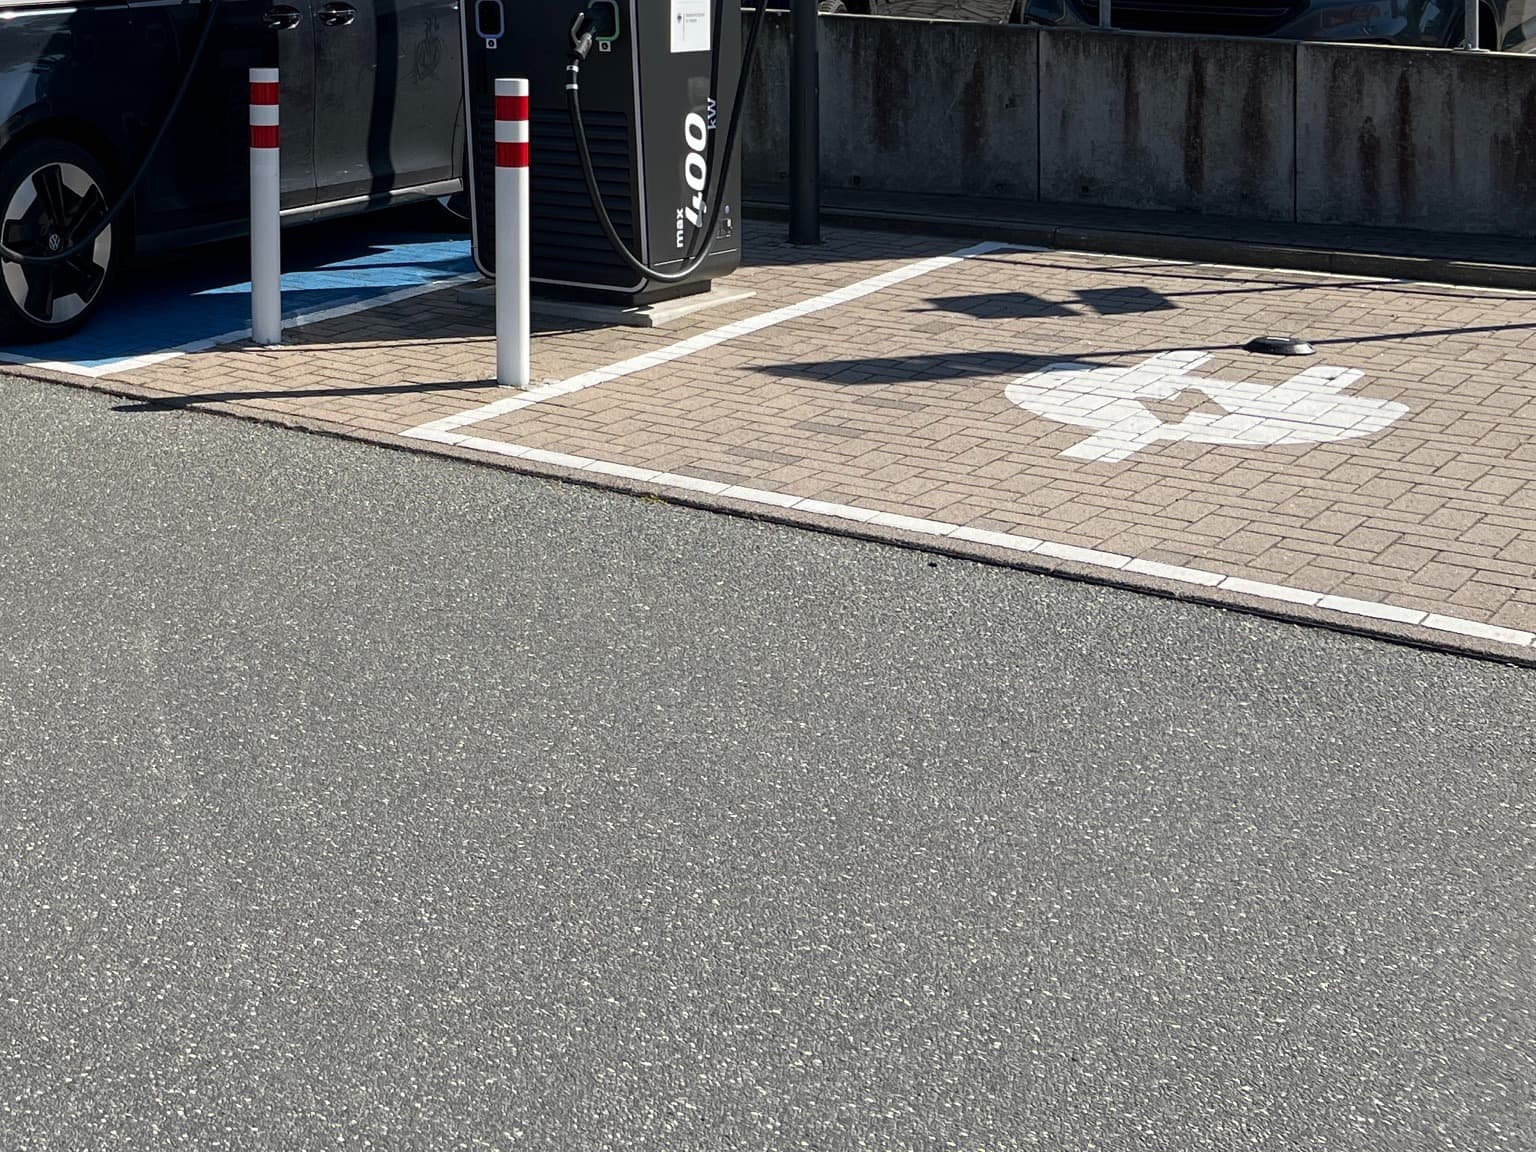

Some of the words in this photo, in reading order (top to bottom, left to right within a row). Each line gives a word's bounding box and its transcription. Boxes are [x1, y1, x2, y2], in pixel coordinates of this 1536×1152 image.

[676, 208, 684, 248] max
[685, 112, 708, 228] 400
[708, 97, 717, 129] kW
